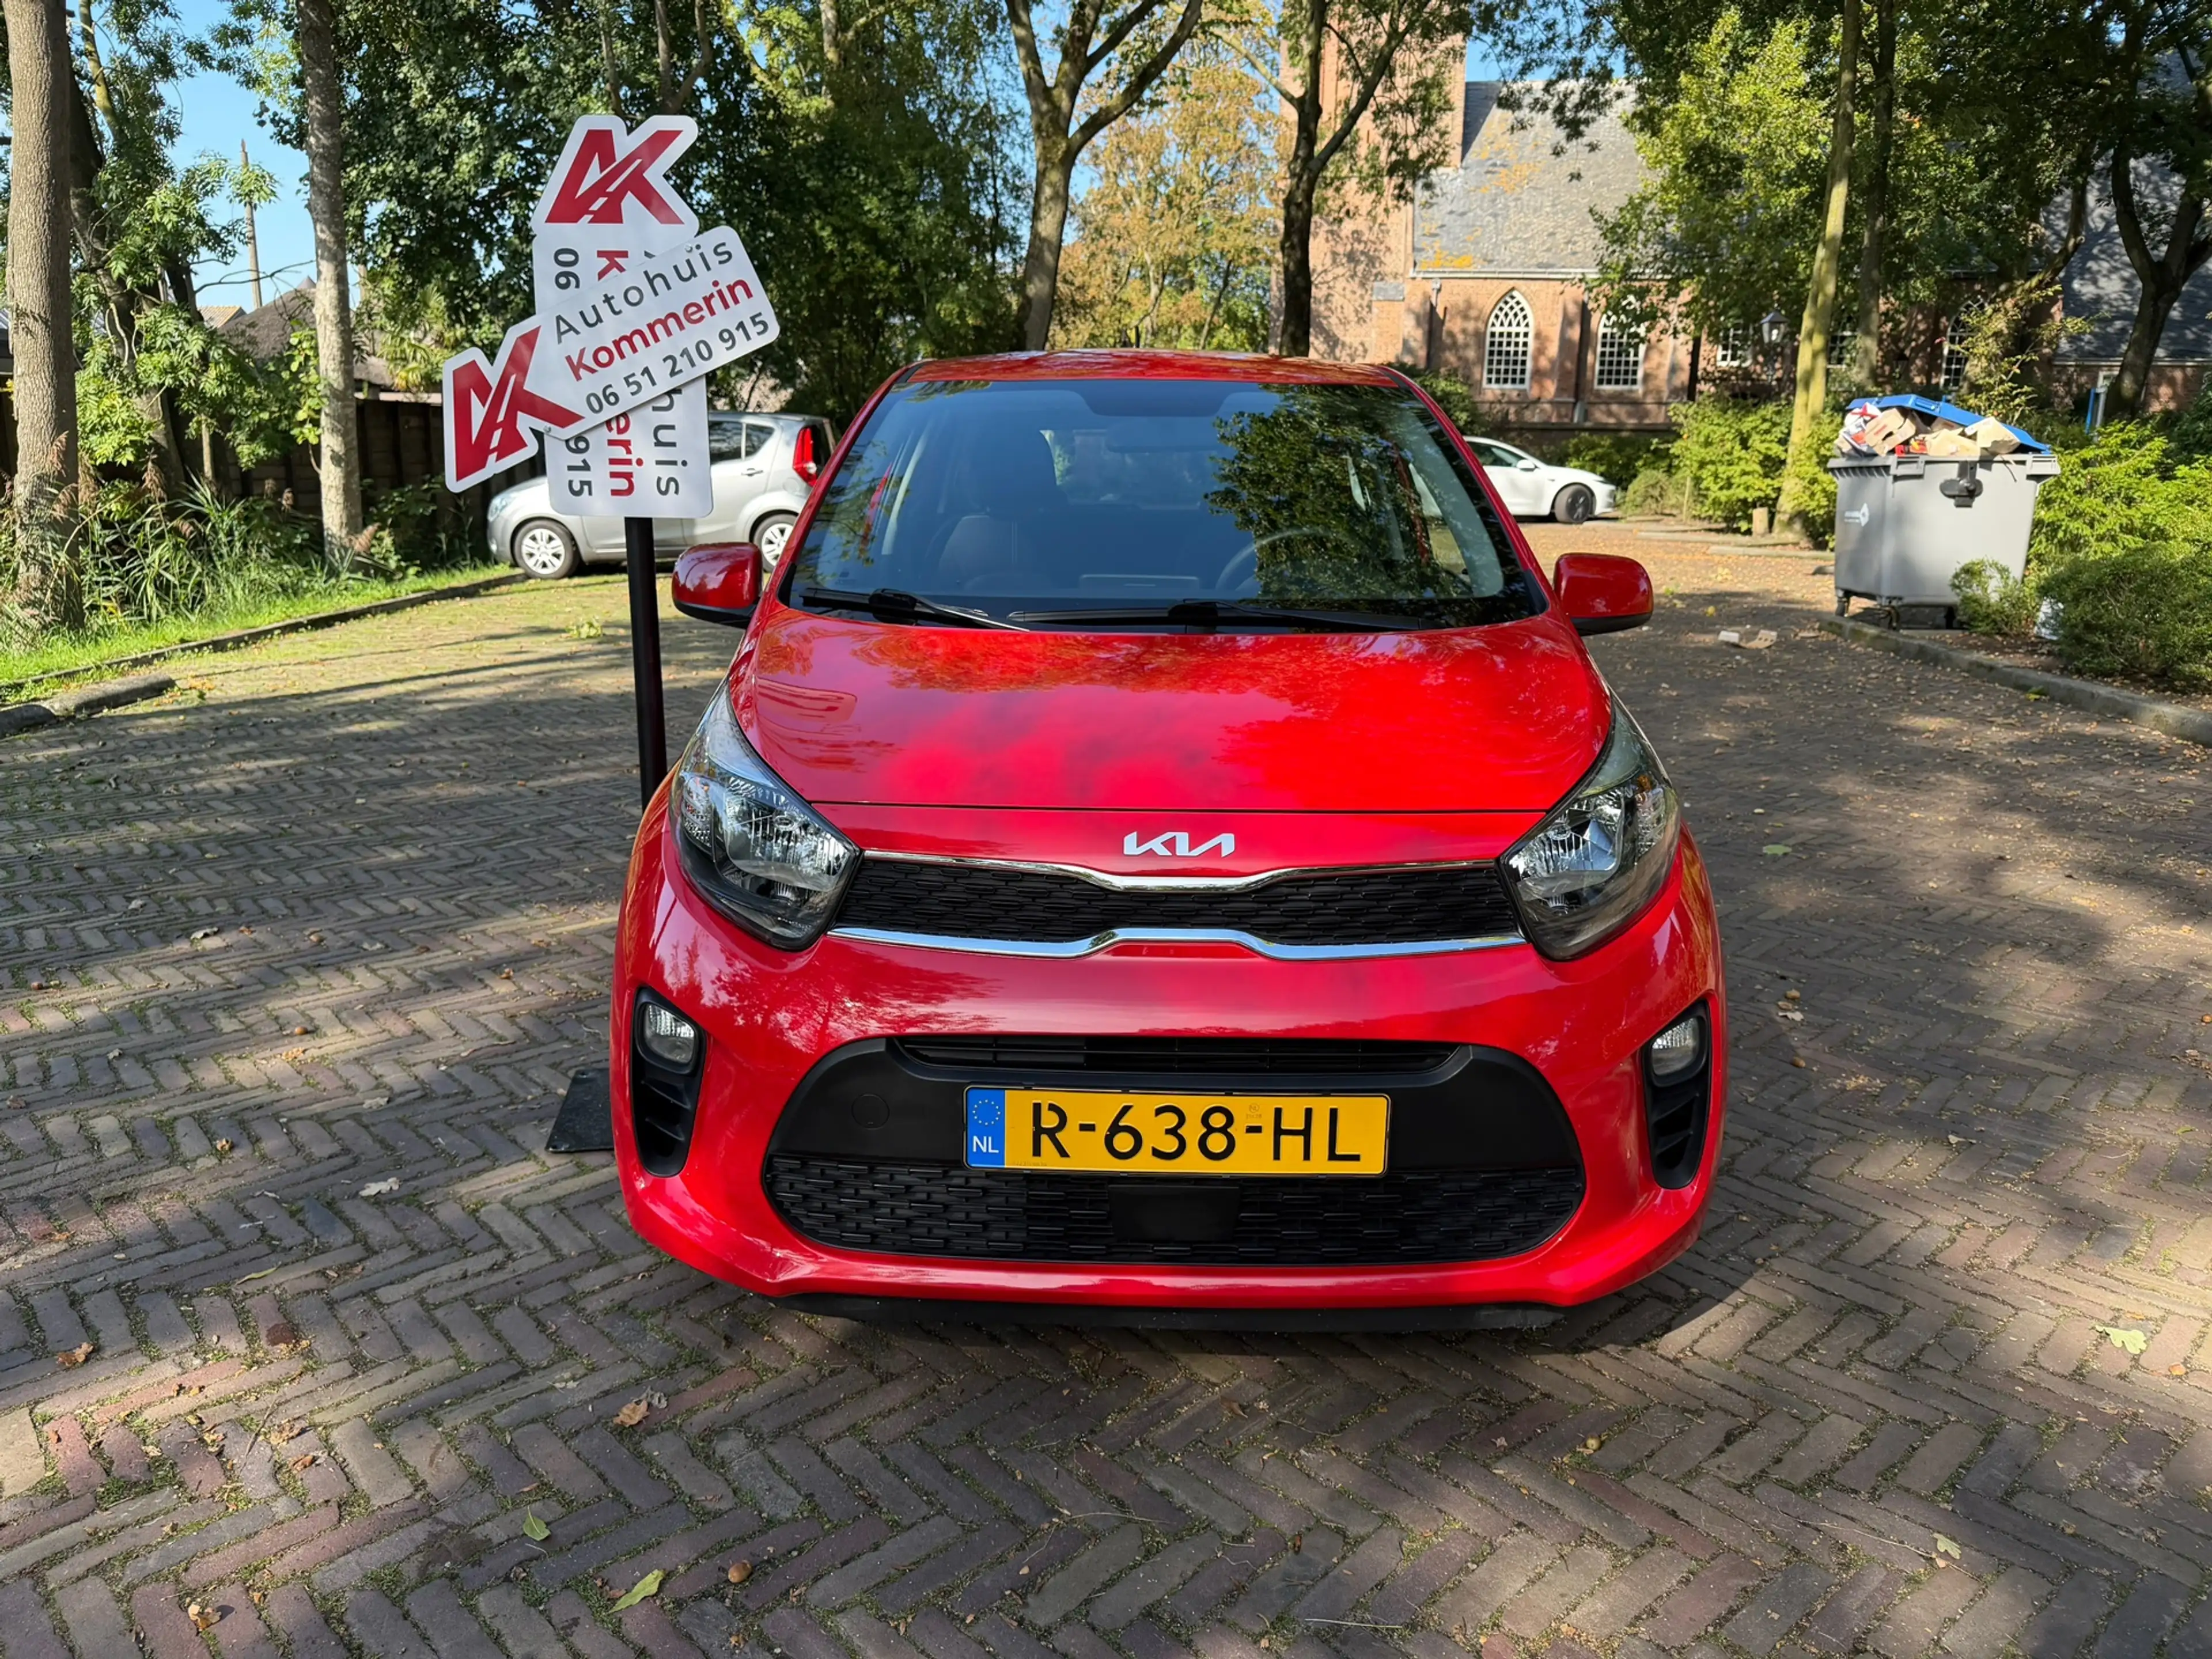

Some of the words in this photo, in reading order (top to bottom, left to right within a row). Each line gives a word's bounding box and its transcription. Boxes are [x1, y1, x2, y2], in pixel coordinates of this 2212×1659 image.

[554, 248, 580, 290] 06
[555, 241, 733, 344] Autohuis
[565, 279, 753, 381] Kommerin
[586, 384, 619, 414] 06
[623, 366, 657, 396] 51
[662, 339, 713, 378] 210
[718, 312, 768, 351] 915
[565, 435, 592, 497] 915
[1124, 831, 1235, 858] KIA
[973, 1135, 999, 1153] NL
[1032, 1103, 1361, 1161] R-638-HL
